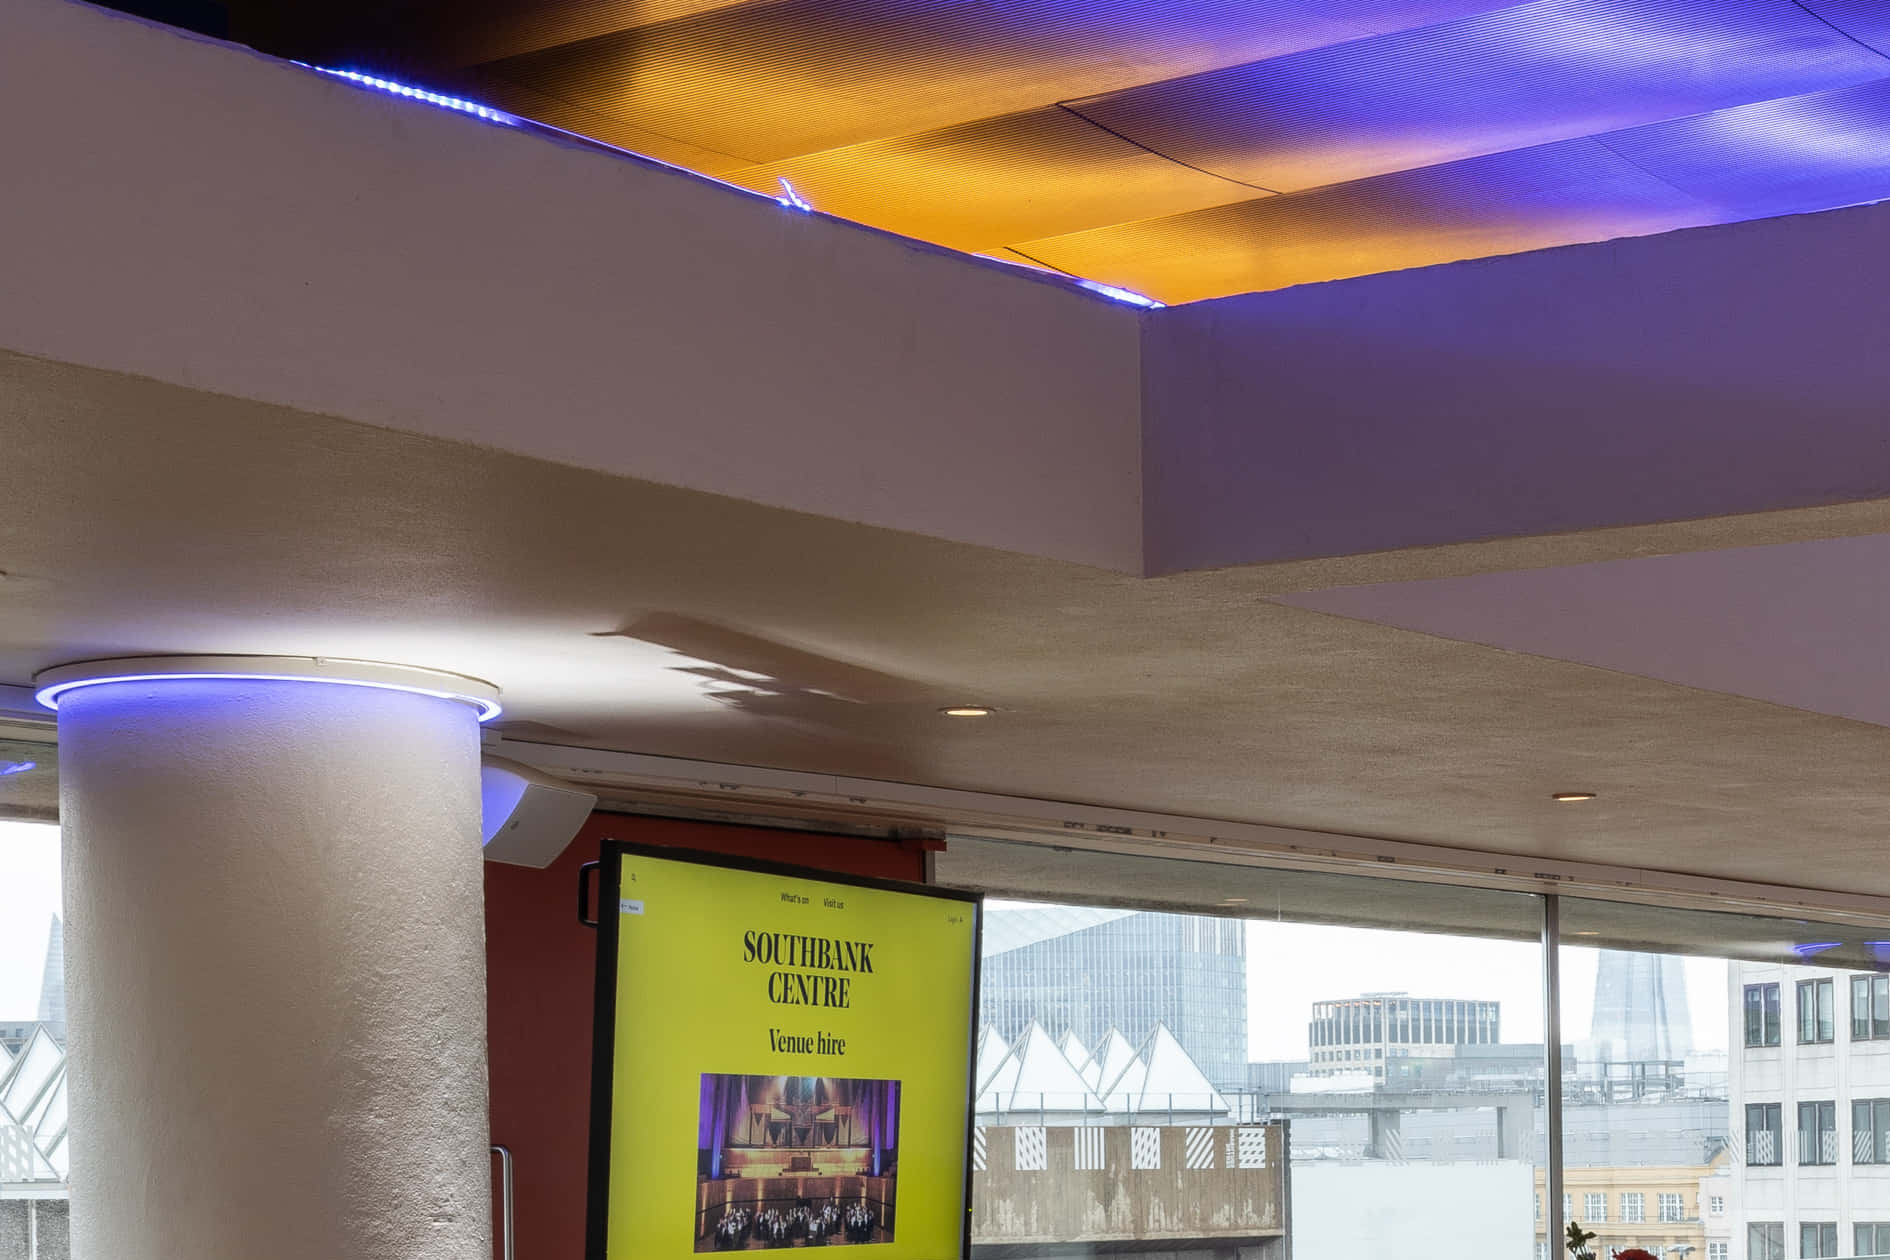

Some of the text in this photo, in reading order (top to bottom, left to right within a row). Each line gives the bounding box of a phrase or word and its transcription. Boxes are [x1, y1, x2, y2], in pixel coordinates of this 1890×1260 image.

[824, 897, 836, 908] Visit
[743, 930, 874, 973] SOUTHBANK
[768, 971, 850, 1008] CENTRE
[769, 1028, 846, 1056] Venue hire
